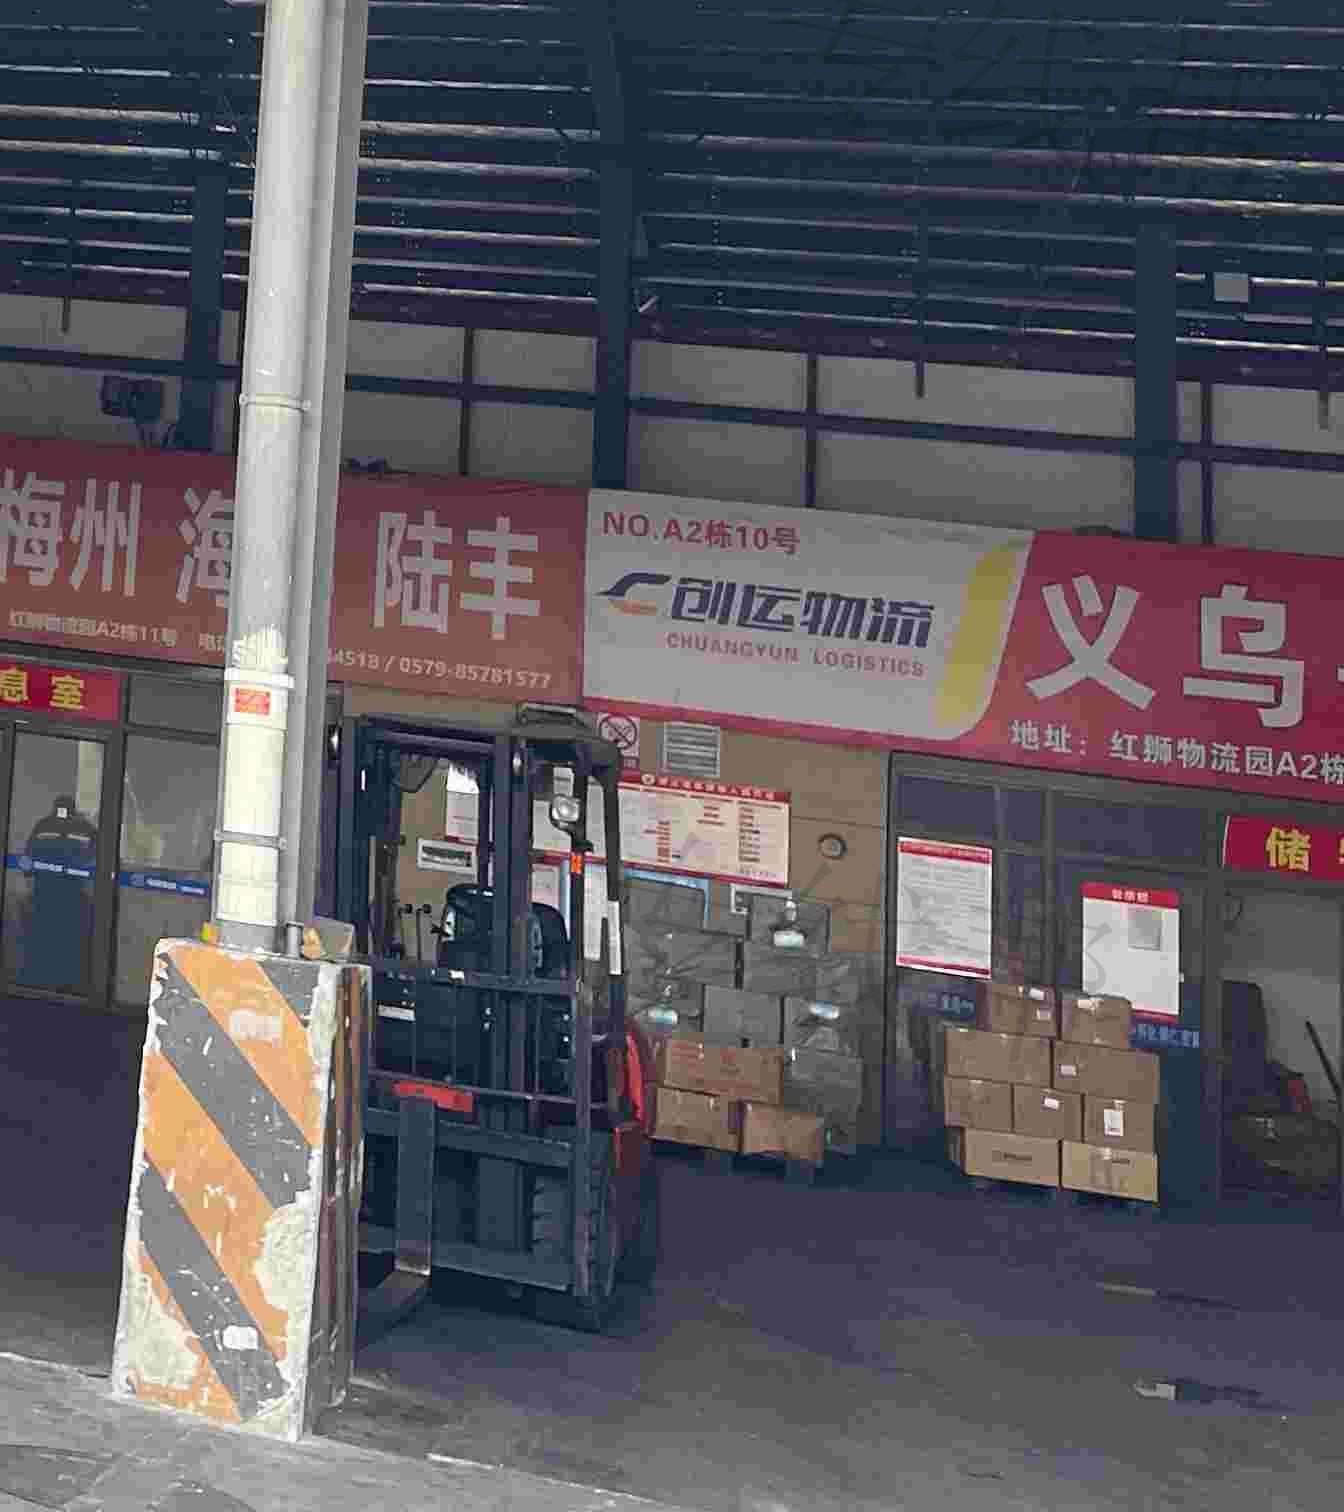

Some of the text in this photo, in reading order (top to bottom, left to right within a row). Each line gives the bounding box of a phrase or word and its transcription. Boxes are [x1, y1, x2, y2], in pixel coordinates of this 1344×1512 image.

[372, 509, 542, 640] 陆丰
[669, 575, 936, 649] 创运物流
[665, 631, 926, 678] CHUANGYUN LOGISTICS
[1024, 573, 1306, 729] 义乌
